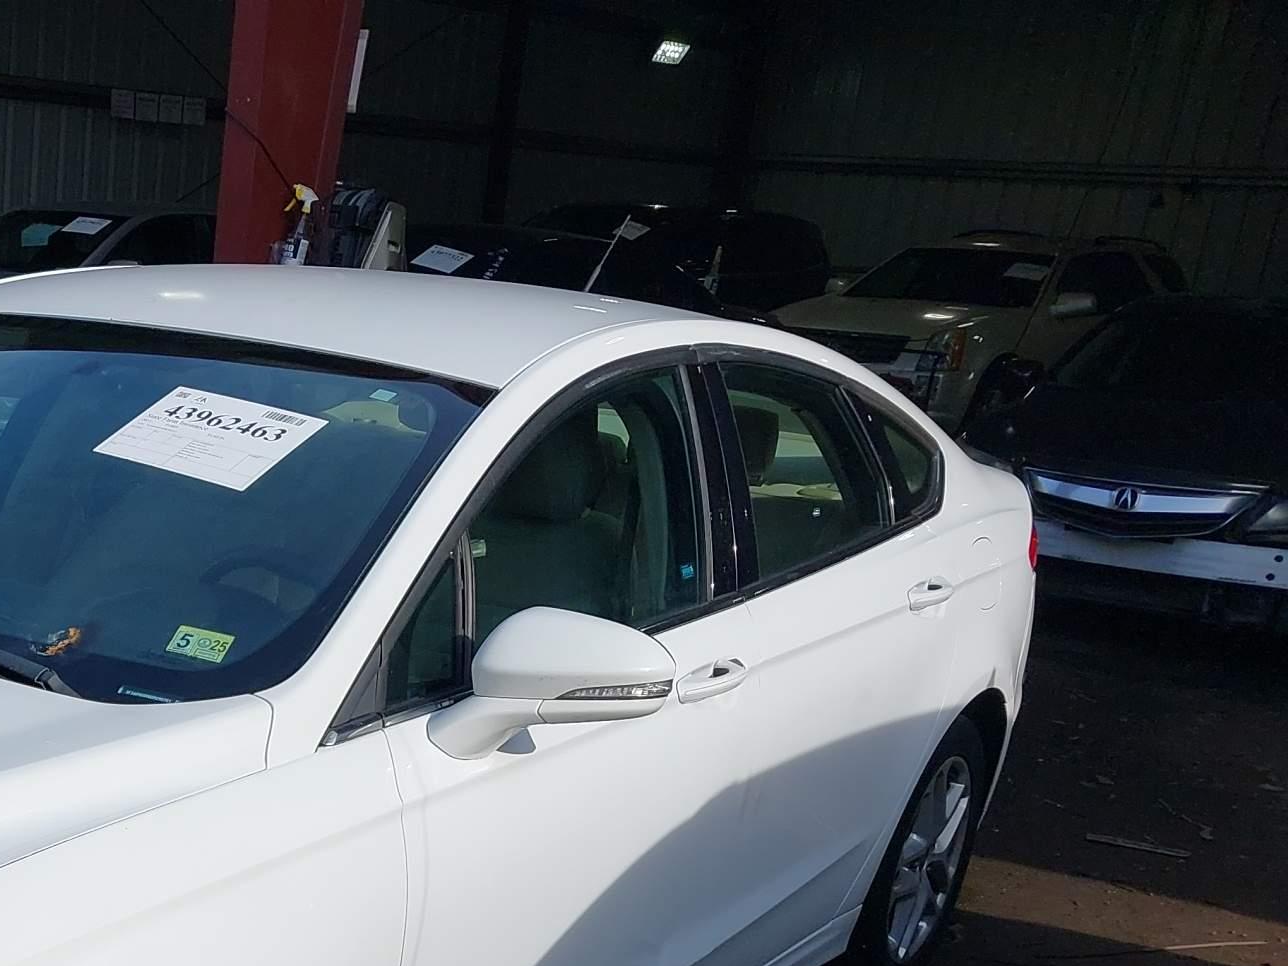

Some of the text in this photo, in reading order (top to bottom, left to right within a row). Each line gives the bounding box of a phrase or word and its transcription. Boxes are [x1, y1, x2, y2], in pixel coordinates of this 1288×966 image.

[164, 404, 288, 442] 43962463
[176, 633, 229, 653] 5 25
